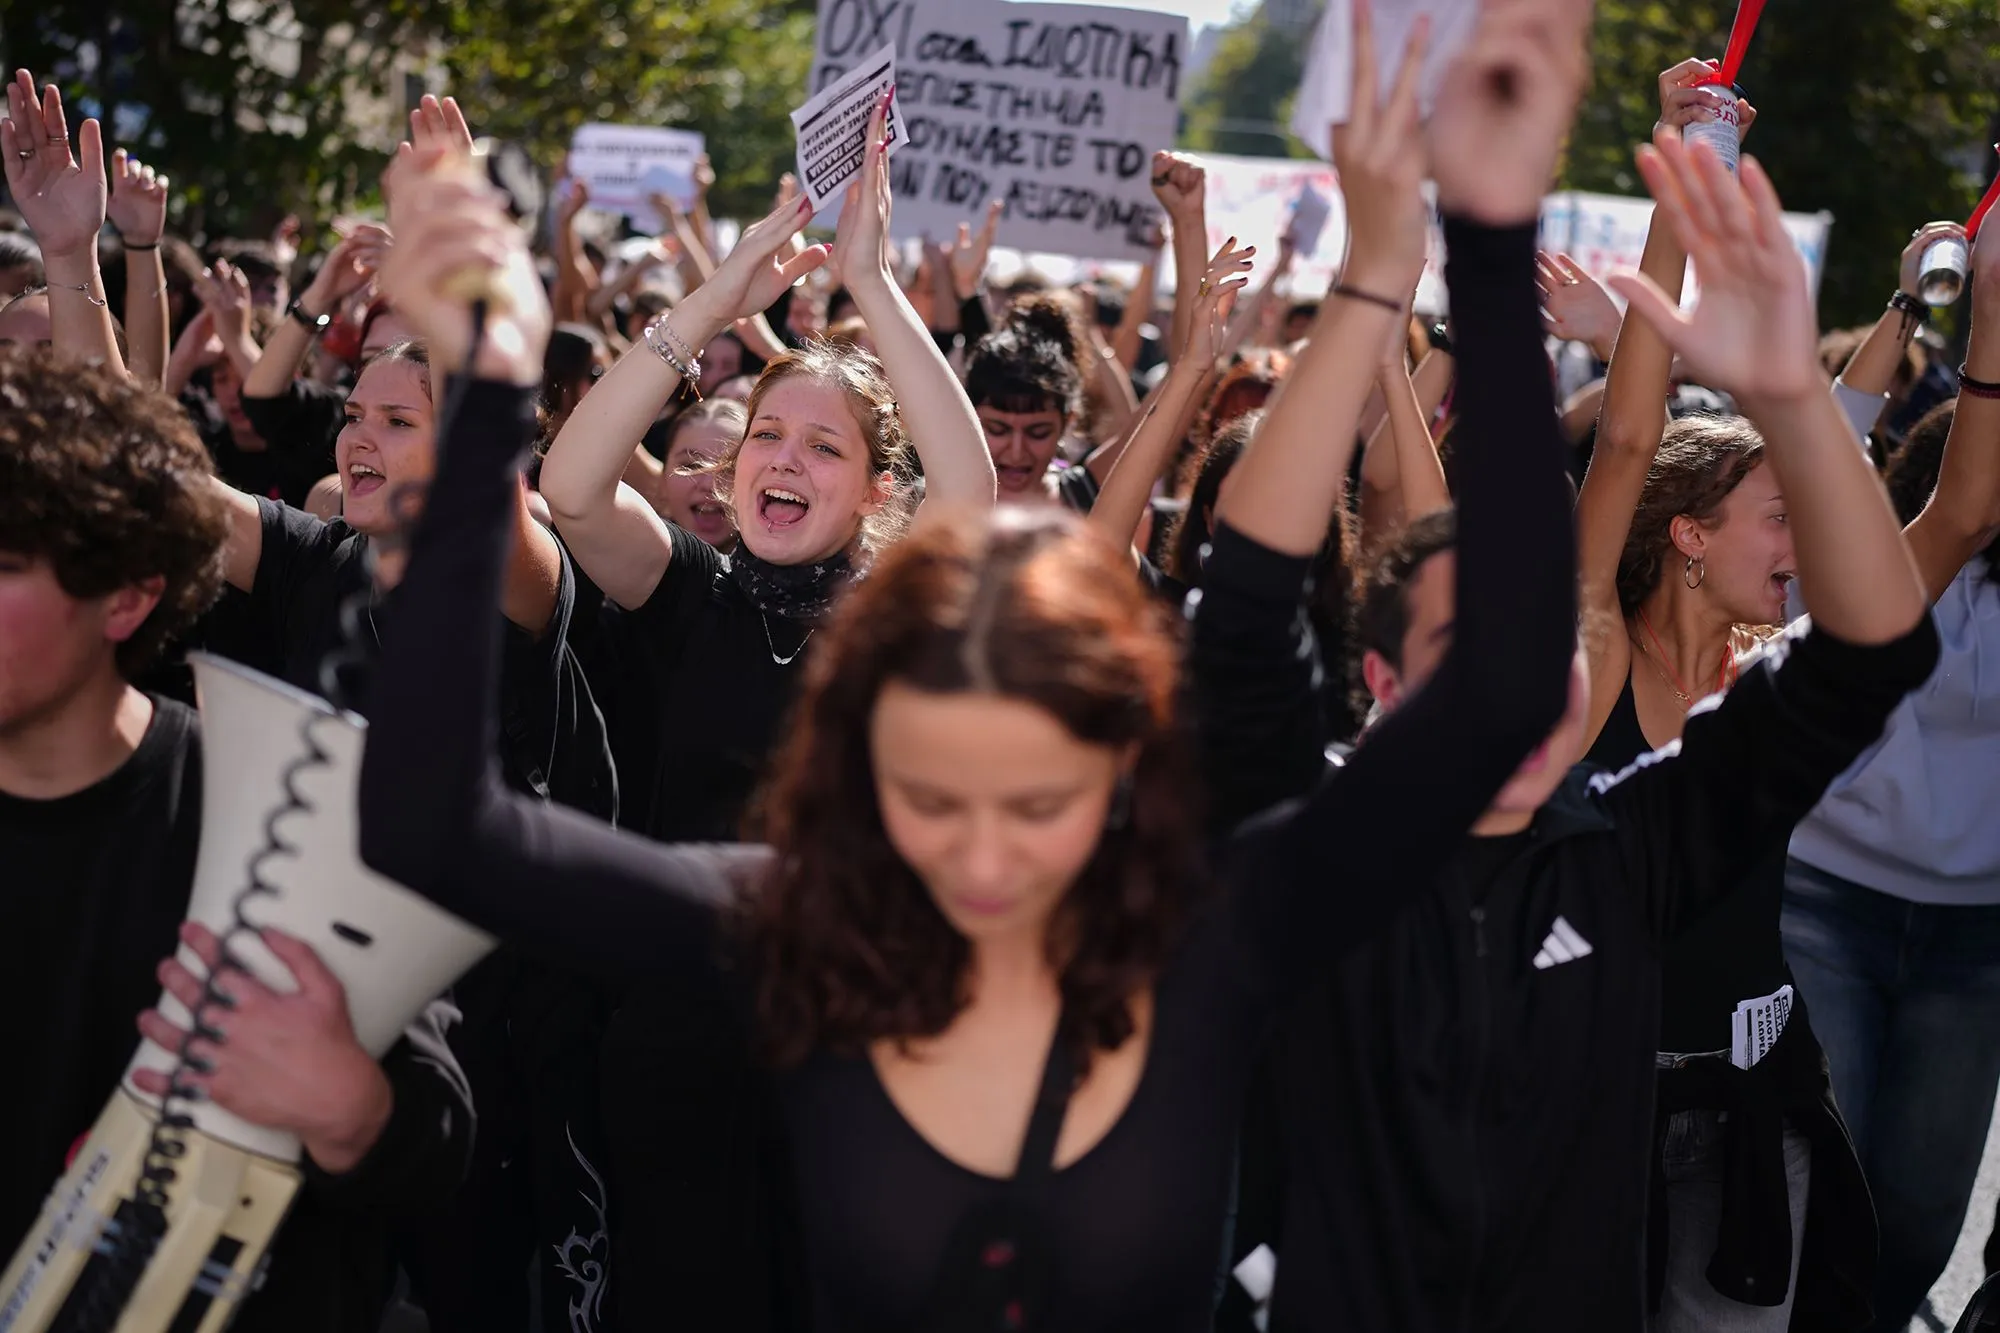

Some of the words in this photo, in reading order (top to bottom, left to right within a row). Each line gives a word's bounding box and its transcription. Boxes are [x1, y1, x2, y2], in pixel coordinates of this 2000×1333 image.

[824, 0, 915, 58] ΟΧΙ
[814, 62, 1106, 127] ΠΕΠΙΣΤΗΜΙΑ
[843, 88, 881, 117] ΔΩΡΕΑΝ
[847, 103, 876, 129] ΟΥΜΕ
[803, 128, 846, 162] ΔΗΜΟΣΙΑ
[905, 116, 1077, 169] ΟΥΜΑΣΤΕ
[1086, 138, 1145, 180] ΤΟ
[816, 157, 855, 194] ΕΛΛΑΔΑ
[1758, 1020, 1766, 1057] ΔΩΡΕΑ
[1765, 1004, 1774, 1049] ΘΕΛΟΥΜ
